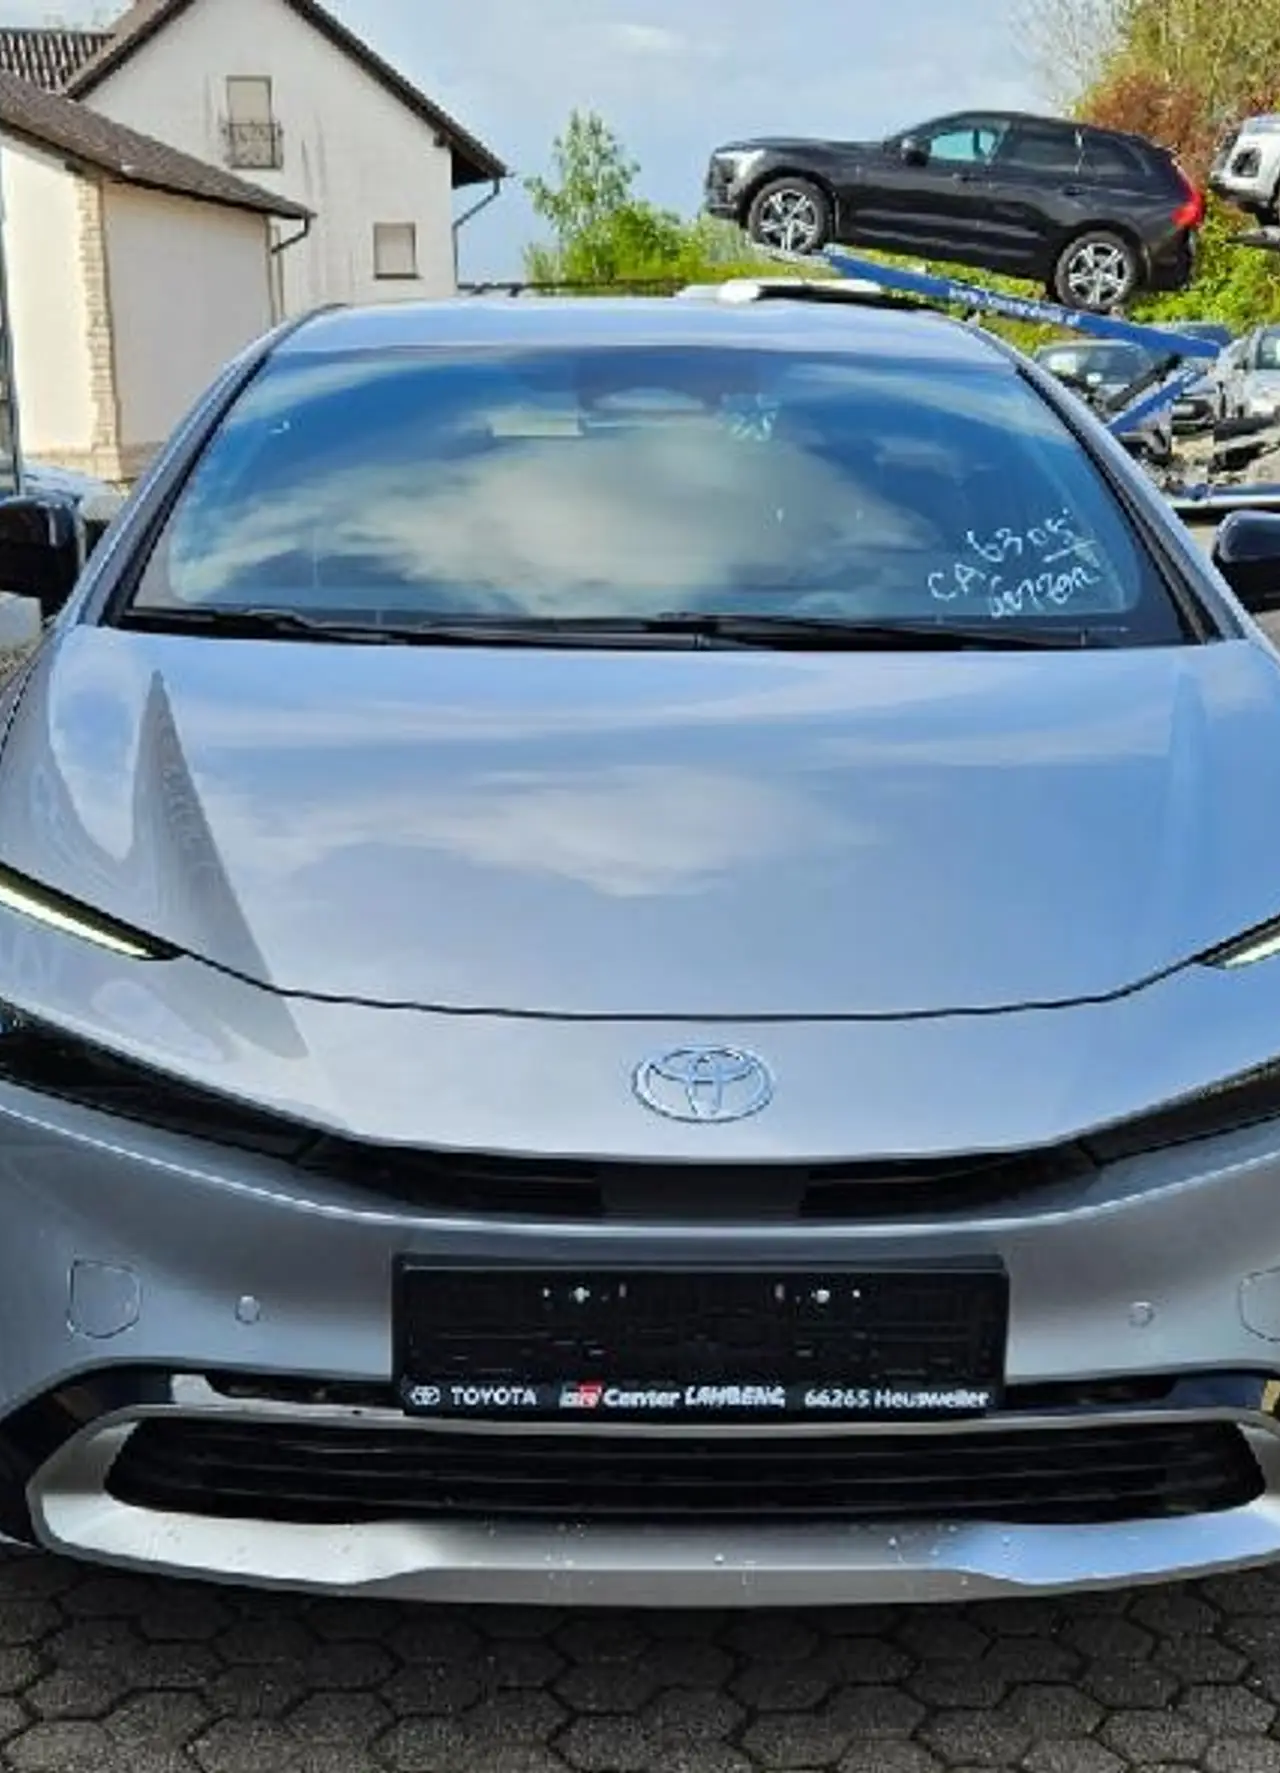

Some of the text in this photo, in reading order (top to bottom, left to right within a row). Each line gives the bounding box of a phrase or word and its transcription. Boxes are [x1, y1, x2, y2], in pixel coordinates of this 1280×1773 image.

[451, 1386, 537, 1406] TOYOTA
[604, 1388, 681, 1408] Center
[805, 1388, 870, 1408] 66265
[874, 1388, 989, 1408] Heusweiler
